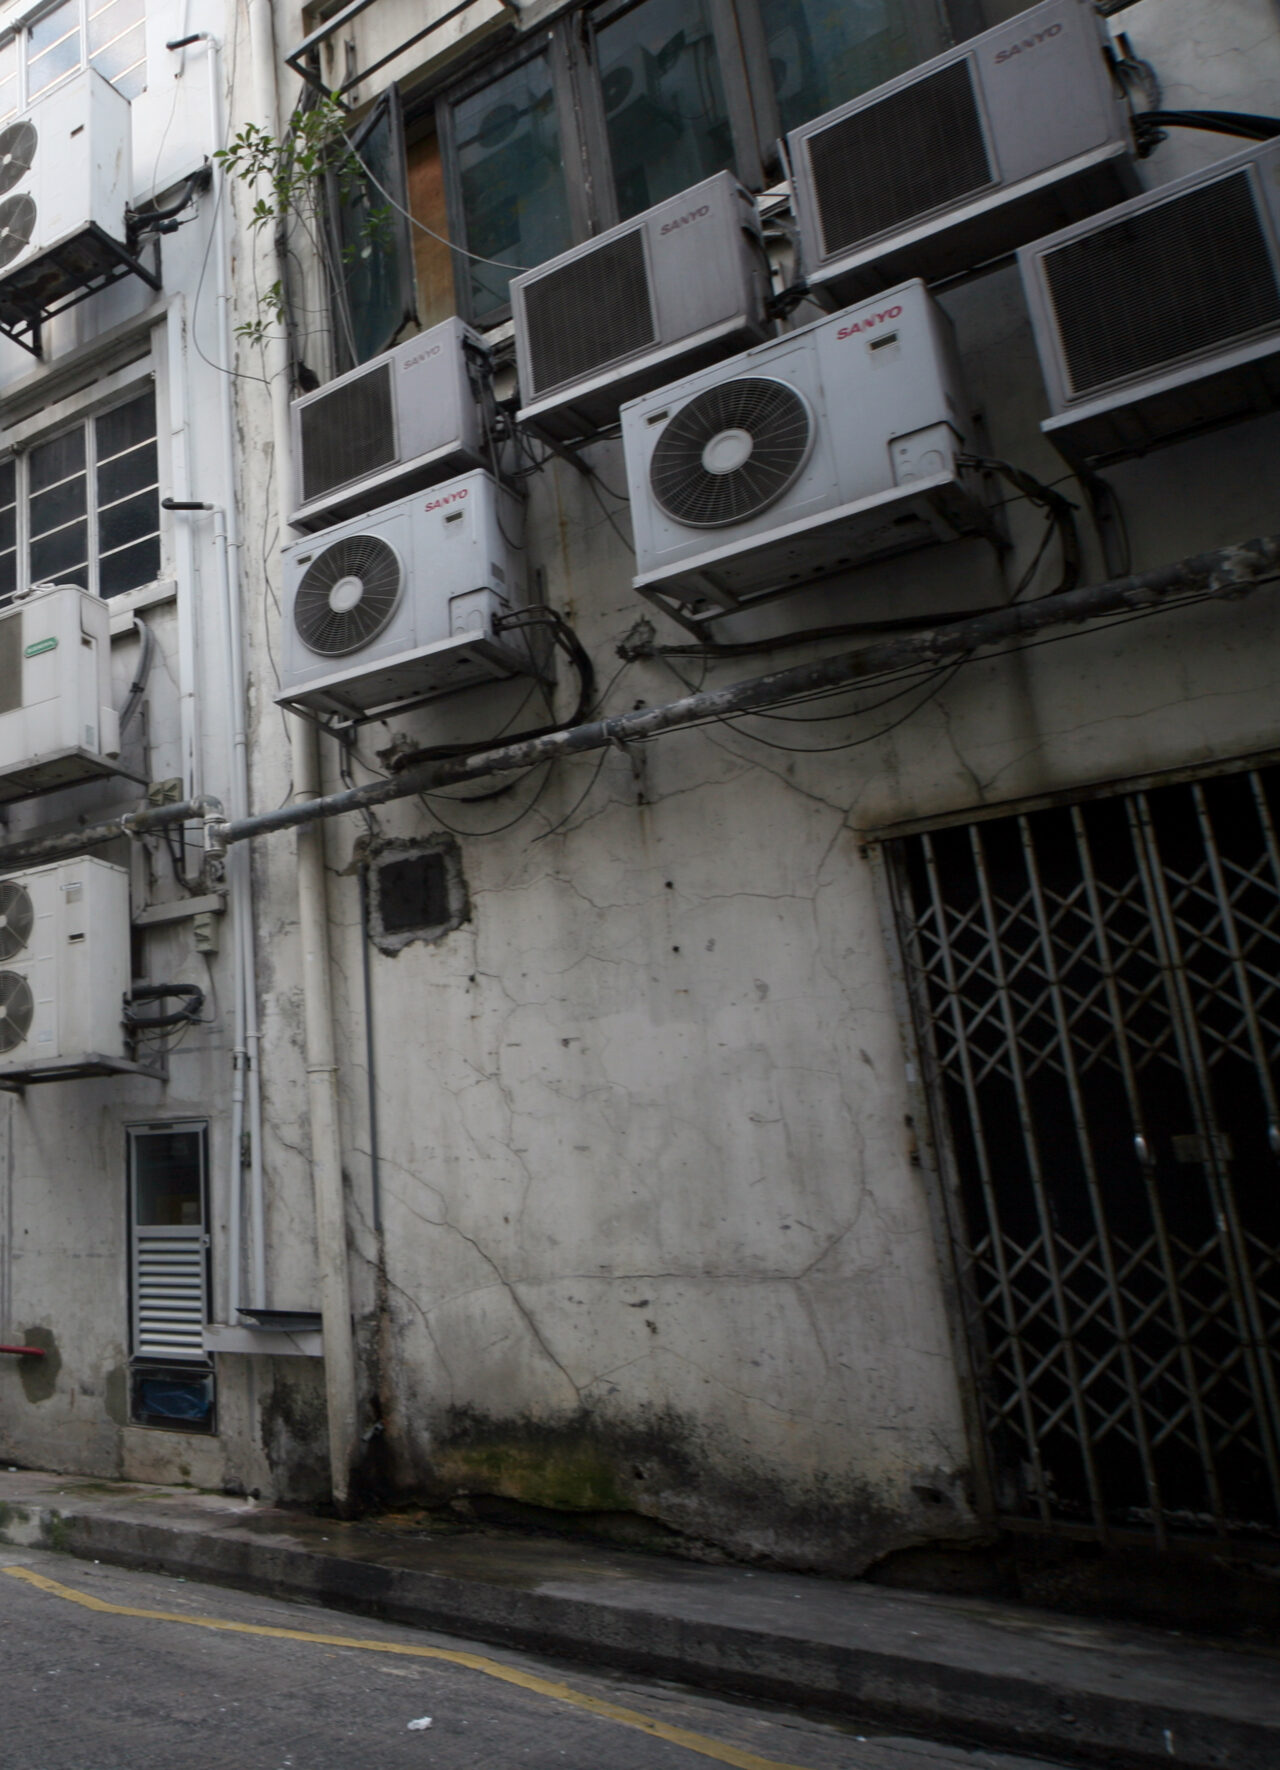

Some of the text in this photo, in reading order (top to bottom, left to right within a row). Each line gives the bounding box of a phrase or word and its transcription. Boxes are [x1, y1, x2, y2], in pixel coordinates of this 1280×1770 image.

[660, 205, 710, 235] SANYO
[836, 305, 903, 340] SANYO
[424, 488, 469, 512] SANYO
